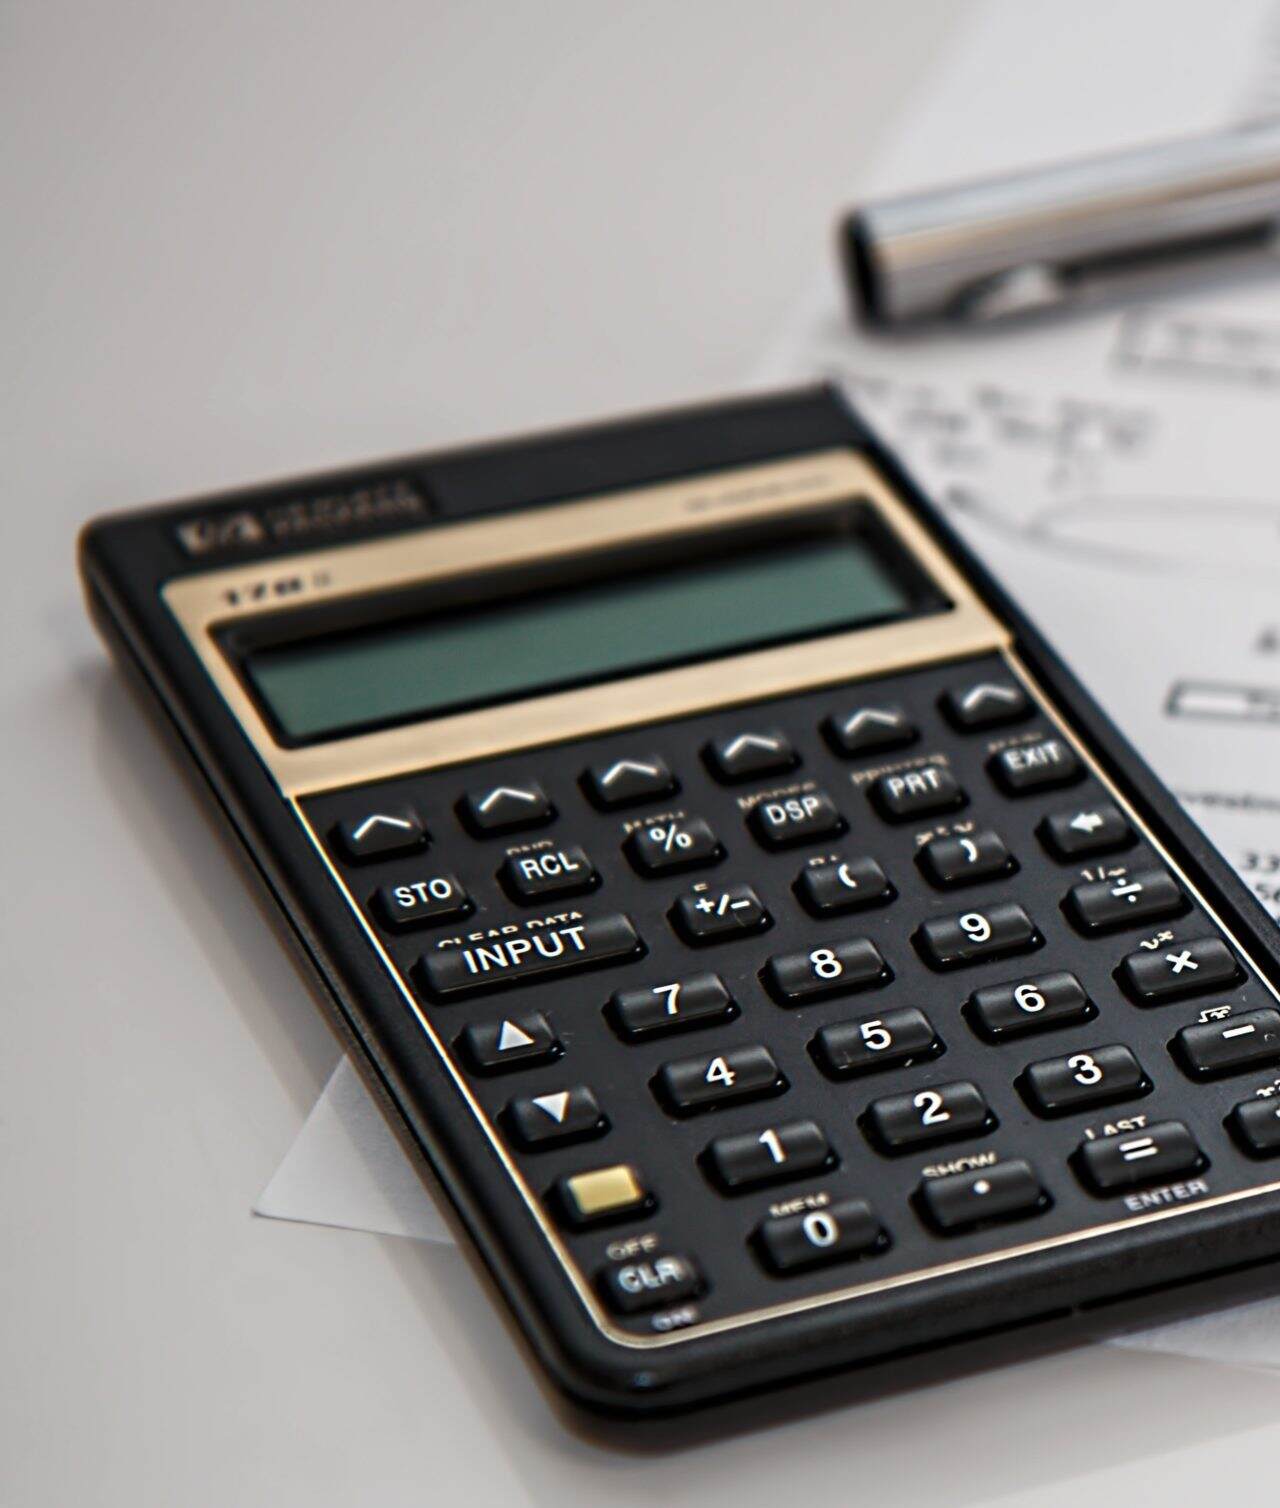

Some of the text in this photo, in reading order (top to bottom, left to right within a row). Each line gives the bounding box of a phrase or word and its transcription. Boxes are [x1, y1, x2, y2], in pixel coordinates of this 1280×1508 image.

[1003, 739, 1060, 770] EXIT
[887, 768, 939, 798] PRT
[764, 797, 818, 824] DSP
[649, 824, 692, 851] %
[519, 852, 579, 880] RCL
[394, 878, 451, 907] STO
[959, 913, 991, 943] 9
[463, 926, 585, 973] INPUT
[809, 949, 842, 979] 8
[653, 983, 680, 1014] 7
[1013, 983, 1046, 1013] 6
[860, 1020, 892, 1051] 5
[705, 1056, 736, 1087] 4
[1067, 1053, 1103, 1085] 3
[913, 1091, 950, 1125] 2
[759, 1129, 786, 1163] 1
[1123, 1179, 1209, 1211] ENTER
[802, 1211, 838, 1248] 0
[618, 1257, 683, 1293] CLR
